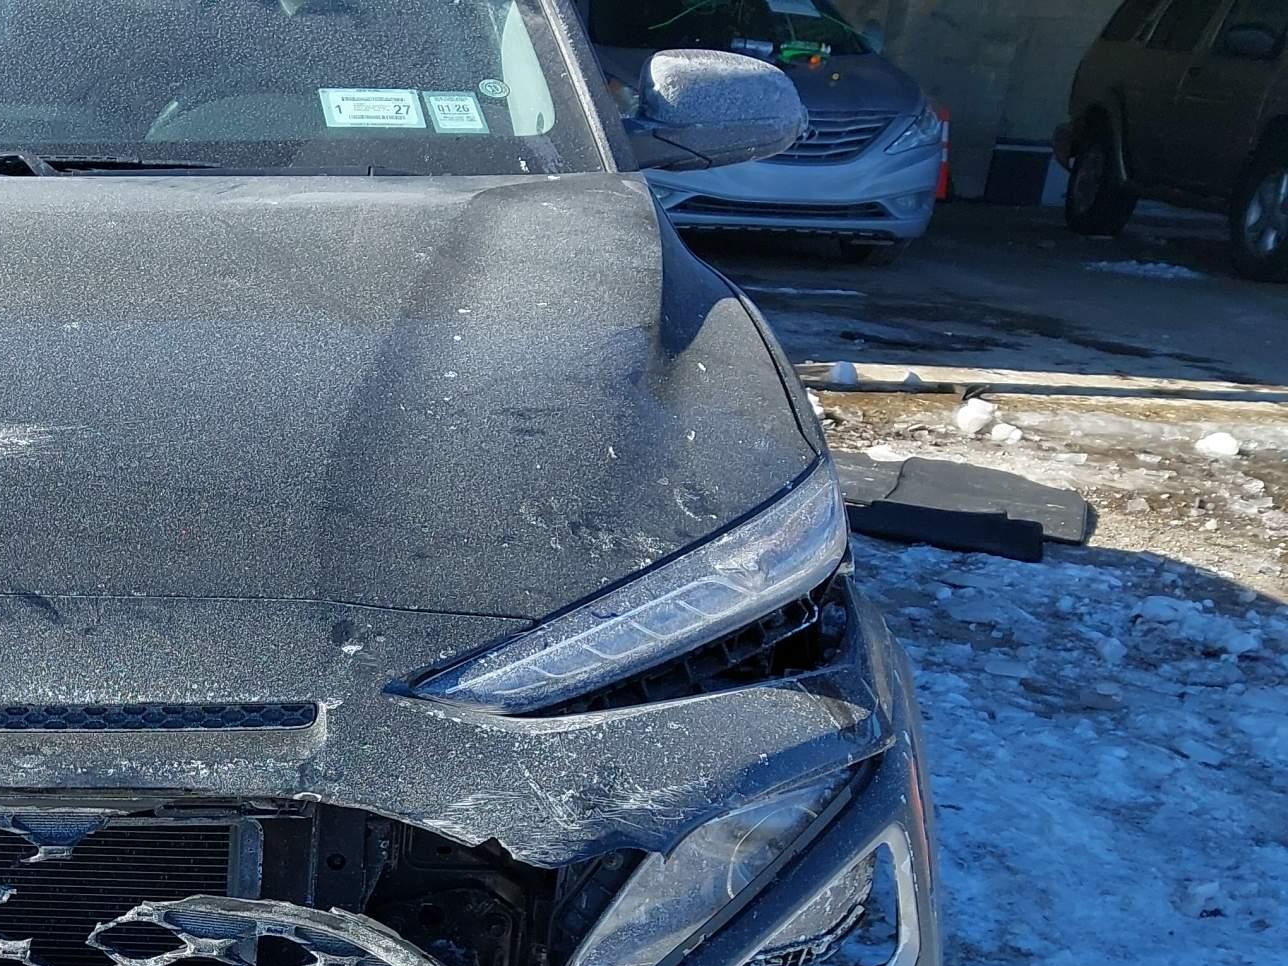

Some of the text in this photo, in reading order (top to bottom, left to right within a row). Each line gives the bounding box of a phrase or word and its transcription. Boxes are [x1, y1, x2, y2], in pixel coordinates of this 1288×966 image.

[335, 104, 342, 114] 1
[393, 104, 410, 114] 27
[455, 104, 470, 113] 26
